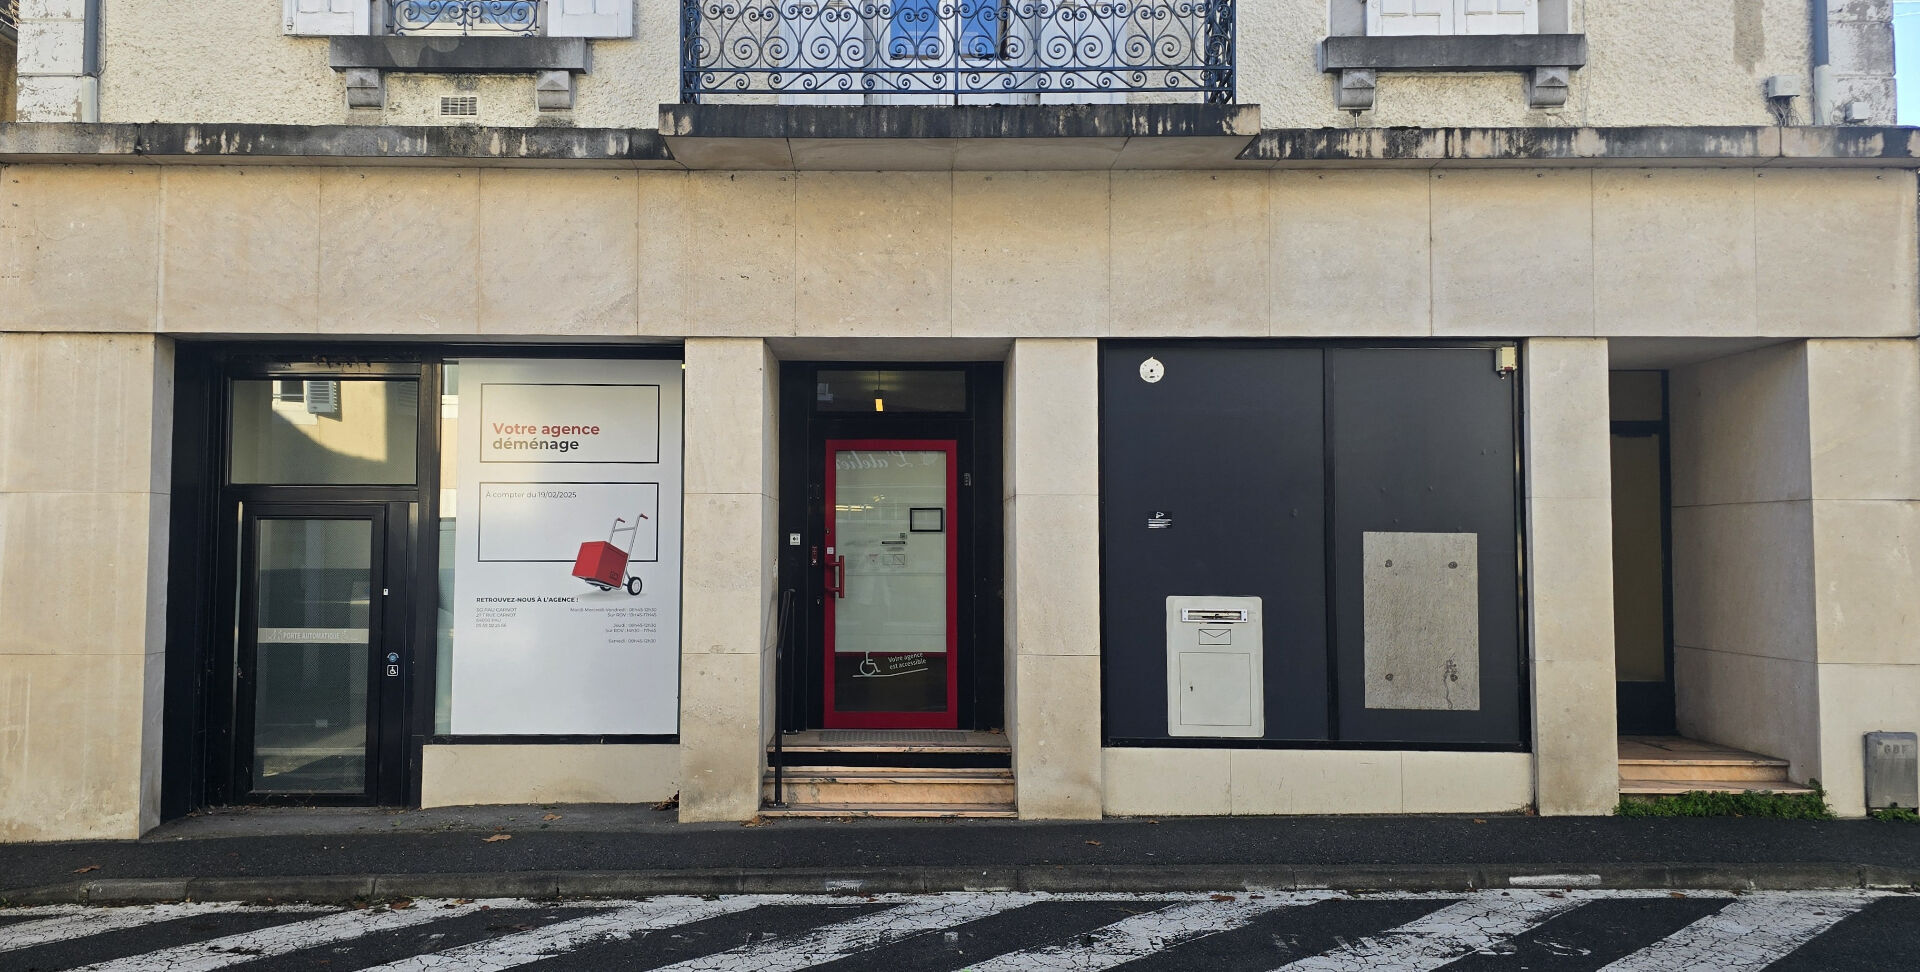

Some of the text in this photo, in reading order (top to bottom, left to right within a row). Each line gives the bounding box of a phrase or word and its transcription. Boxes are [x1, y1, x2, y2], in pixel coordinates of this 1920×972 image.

[492, 423, 600, 437] Votre agence
[492, 438, 579, 453] déménage
[492, 491, 525, 499] compter
[538, 491, 577, 499] 19/02/2025
[537, 595, 542, 603] À
[283, 632, 340, 640] PORTE AUTOMATIQUE
[888, 655, 903, 663] Votre
[898, 659, 926, 668] accessible
